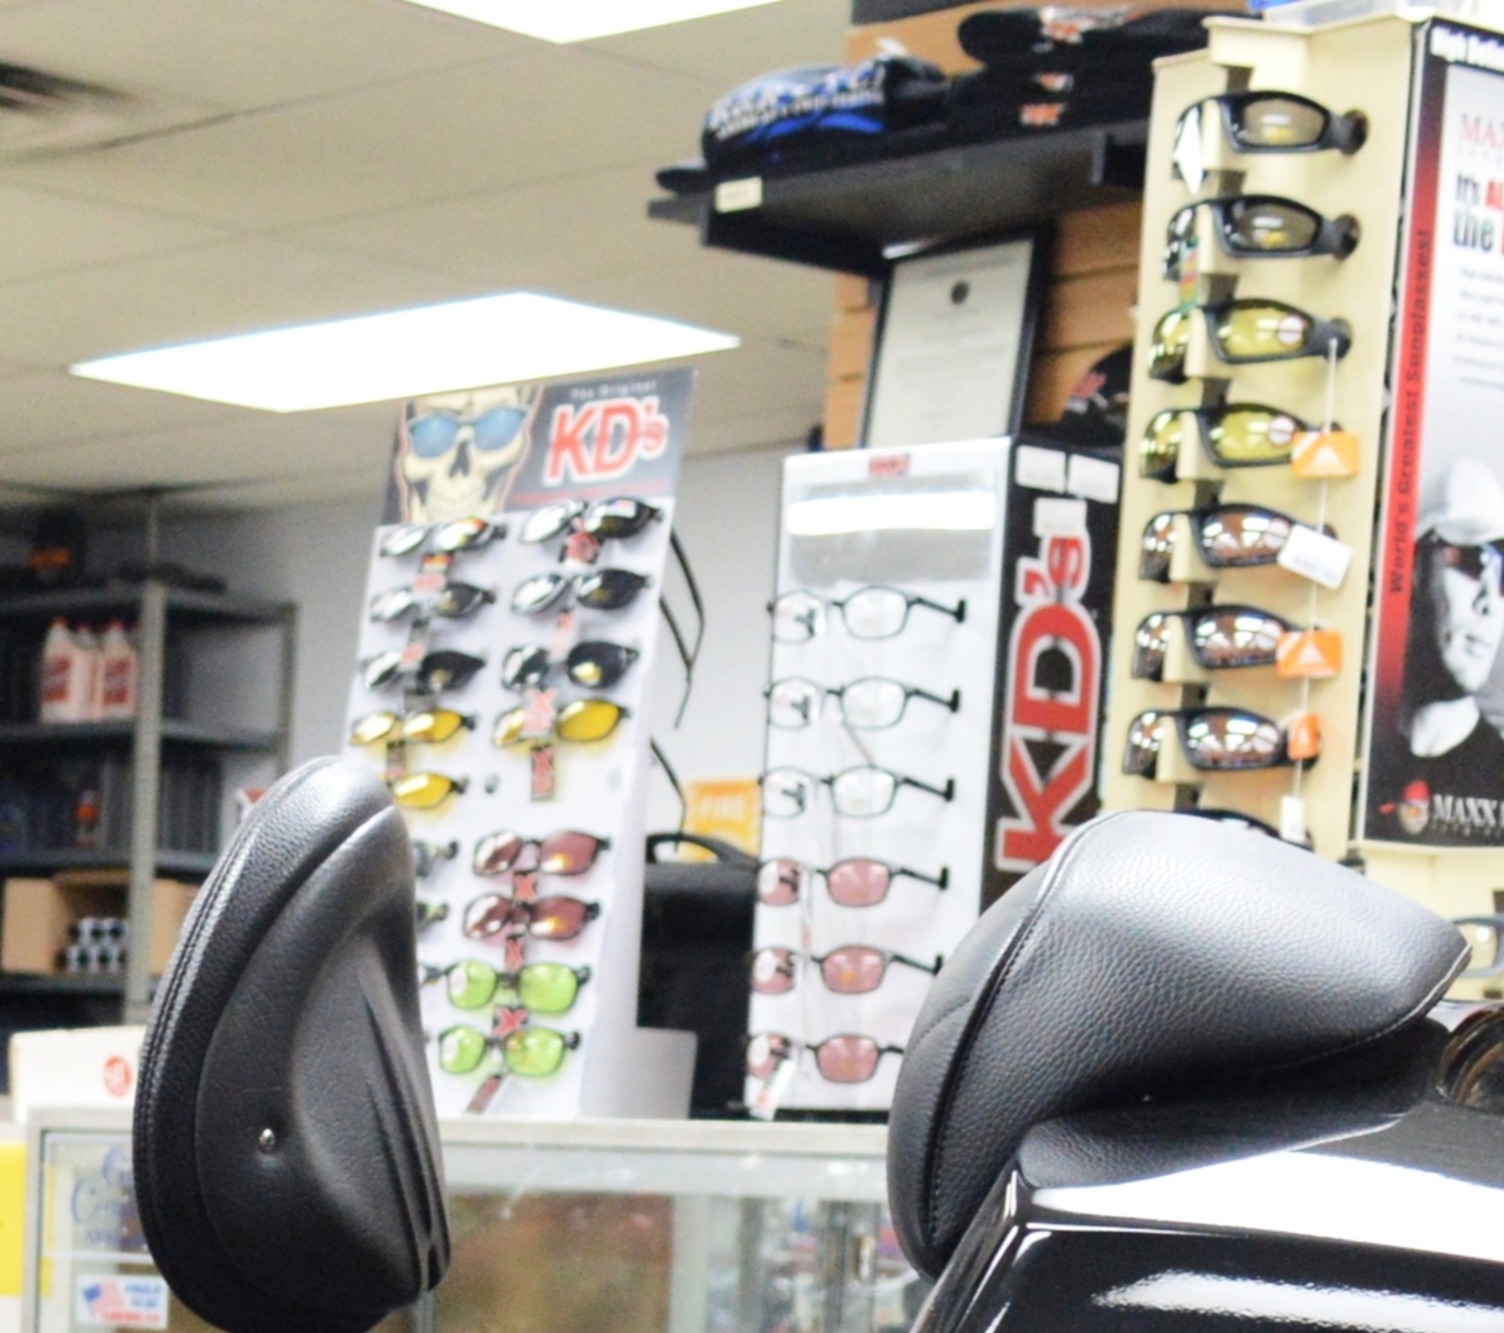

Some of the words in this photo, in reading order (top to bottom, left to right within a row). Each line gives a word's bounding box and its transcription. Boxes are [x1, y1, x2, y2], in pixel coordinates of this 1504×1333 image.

[1452, 208, 1494, 253] the
[543, 397, 669, 486] KD's
[996, 534, 1101, 872] KD's
[1432, 793, 1498, 828] MAXX
